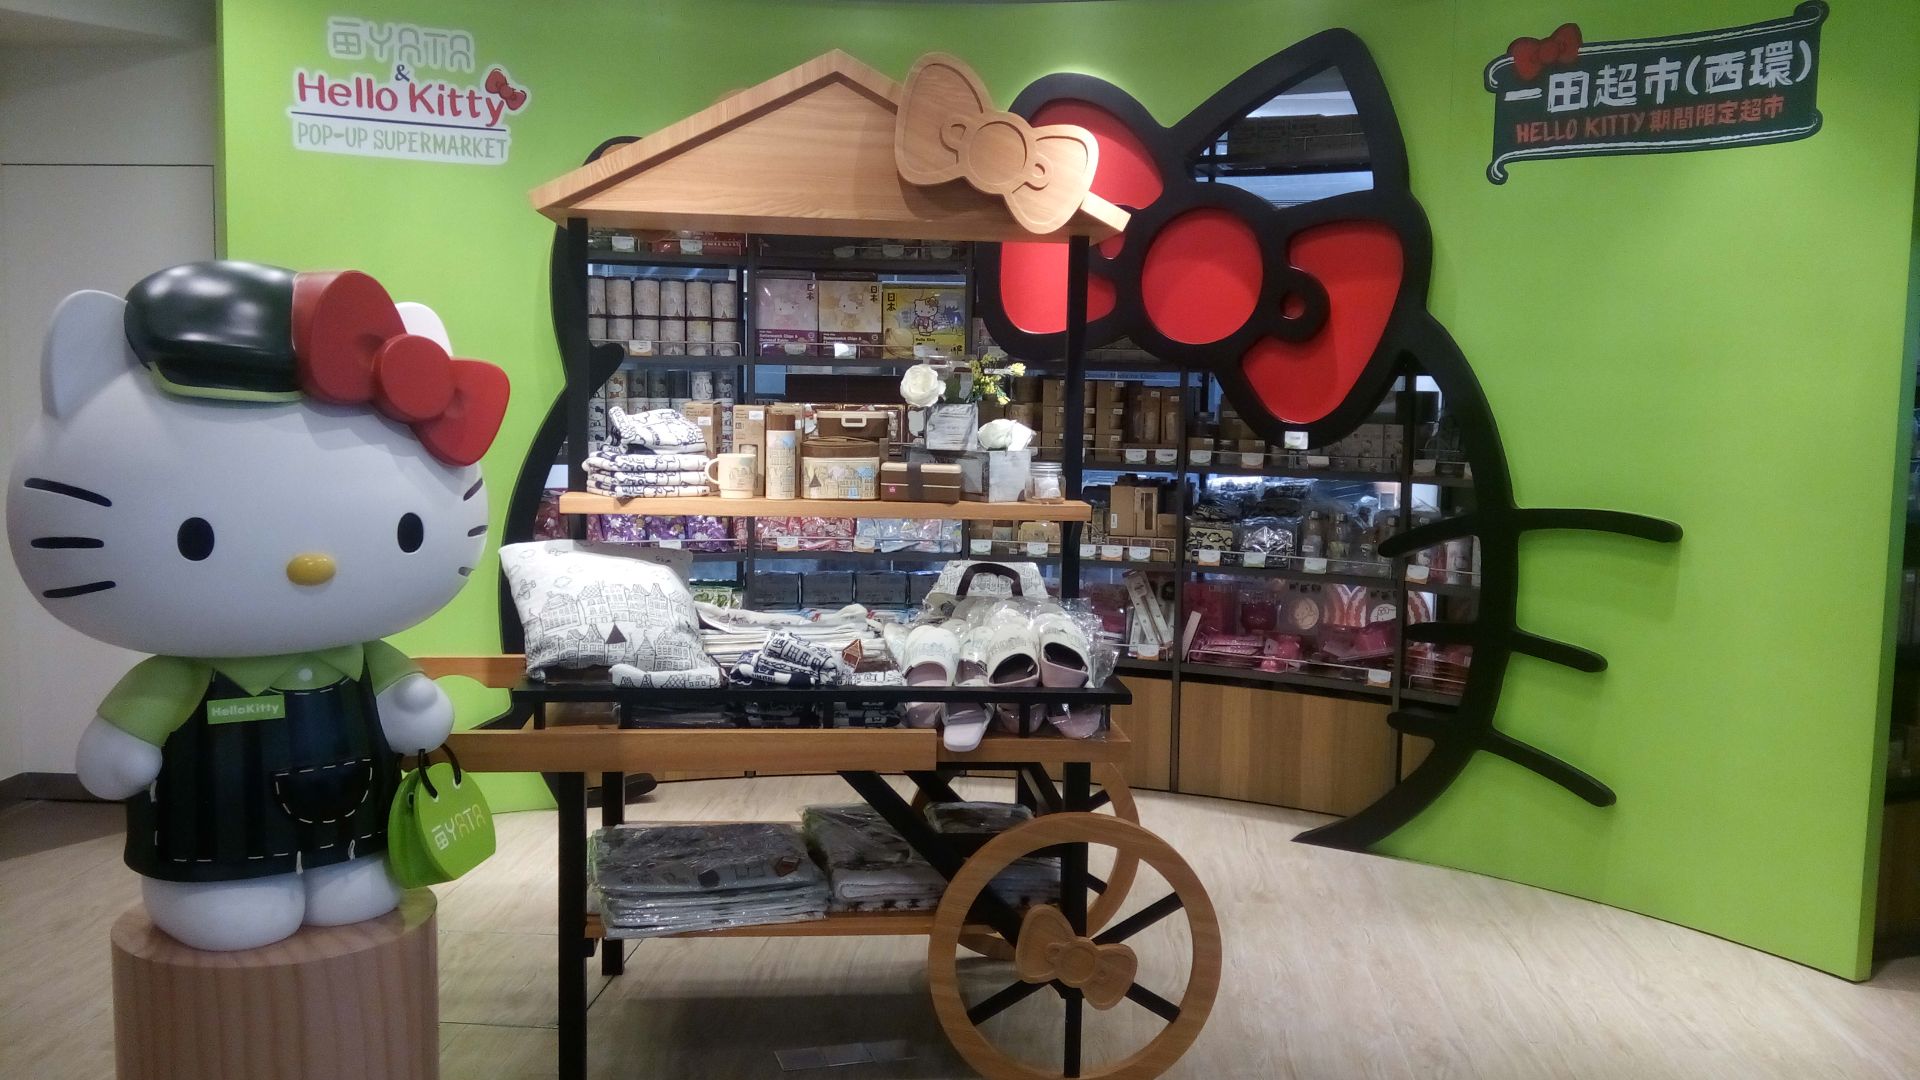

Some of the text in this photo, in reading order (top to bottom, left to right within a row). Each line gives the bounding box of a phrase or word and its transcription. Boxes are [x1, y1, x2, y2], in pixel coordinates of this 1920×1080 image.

[394, 64, 410, 82] &
[297, 71, 505, 128] Hello Kitty
[1516, 94, 1785, 144] HELLO KITTY 期間限定超市
[297, 122, 508, 160] POP-UP SUPERMARKET
[887, 292, 897, 311] 日本
